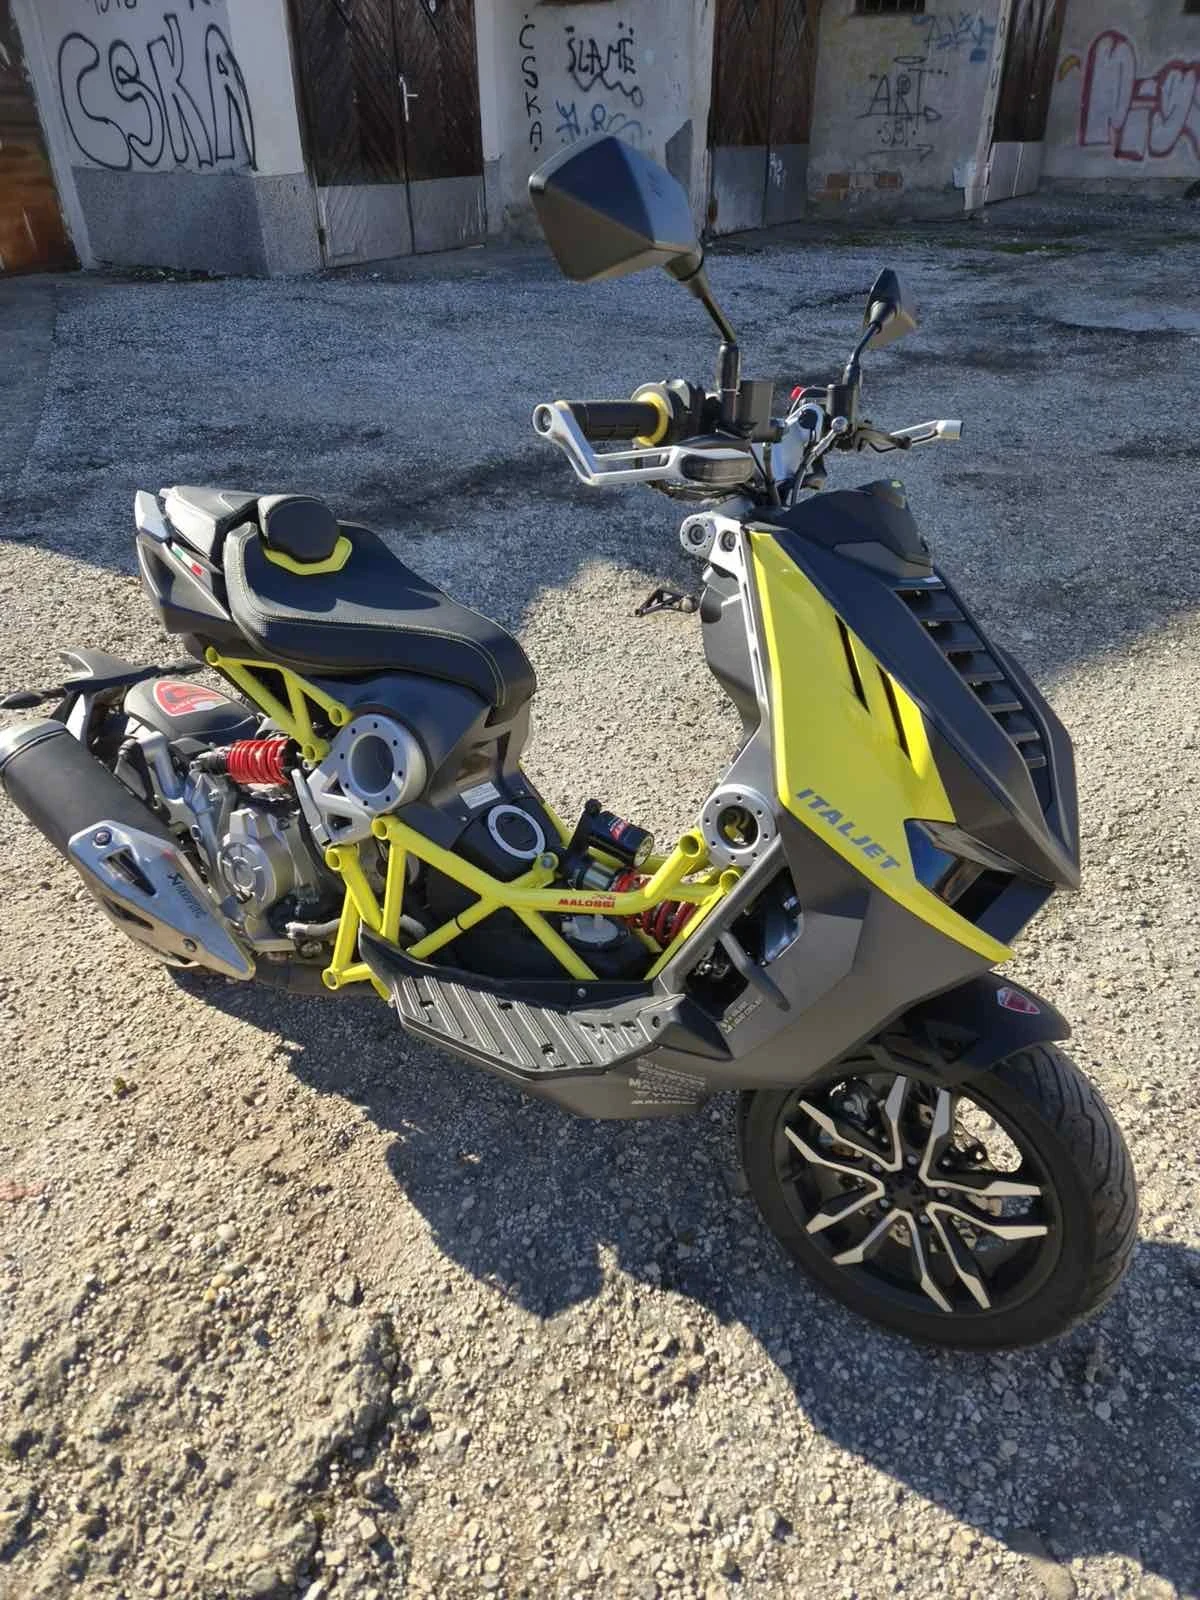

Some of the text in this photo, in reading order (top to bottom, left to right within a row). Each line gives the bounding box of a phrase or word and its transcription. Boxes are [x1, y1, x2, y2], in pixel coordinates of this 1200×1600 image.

[58, 14, 257, 170] CSKA
[796, 787, 901, 869] ITALJET
[558, 898, 615, 909] MALOSSI
